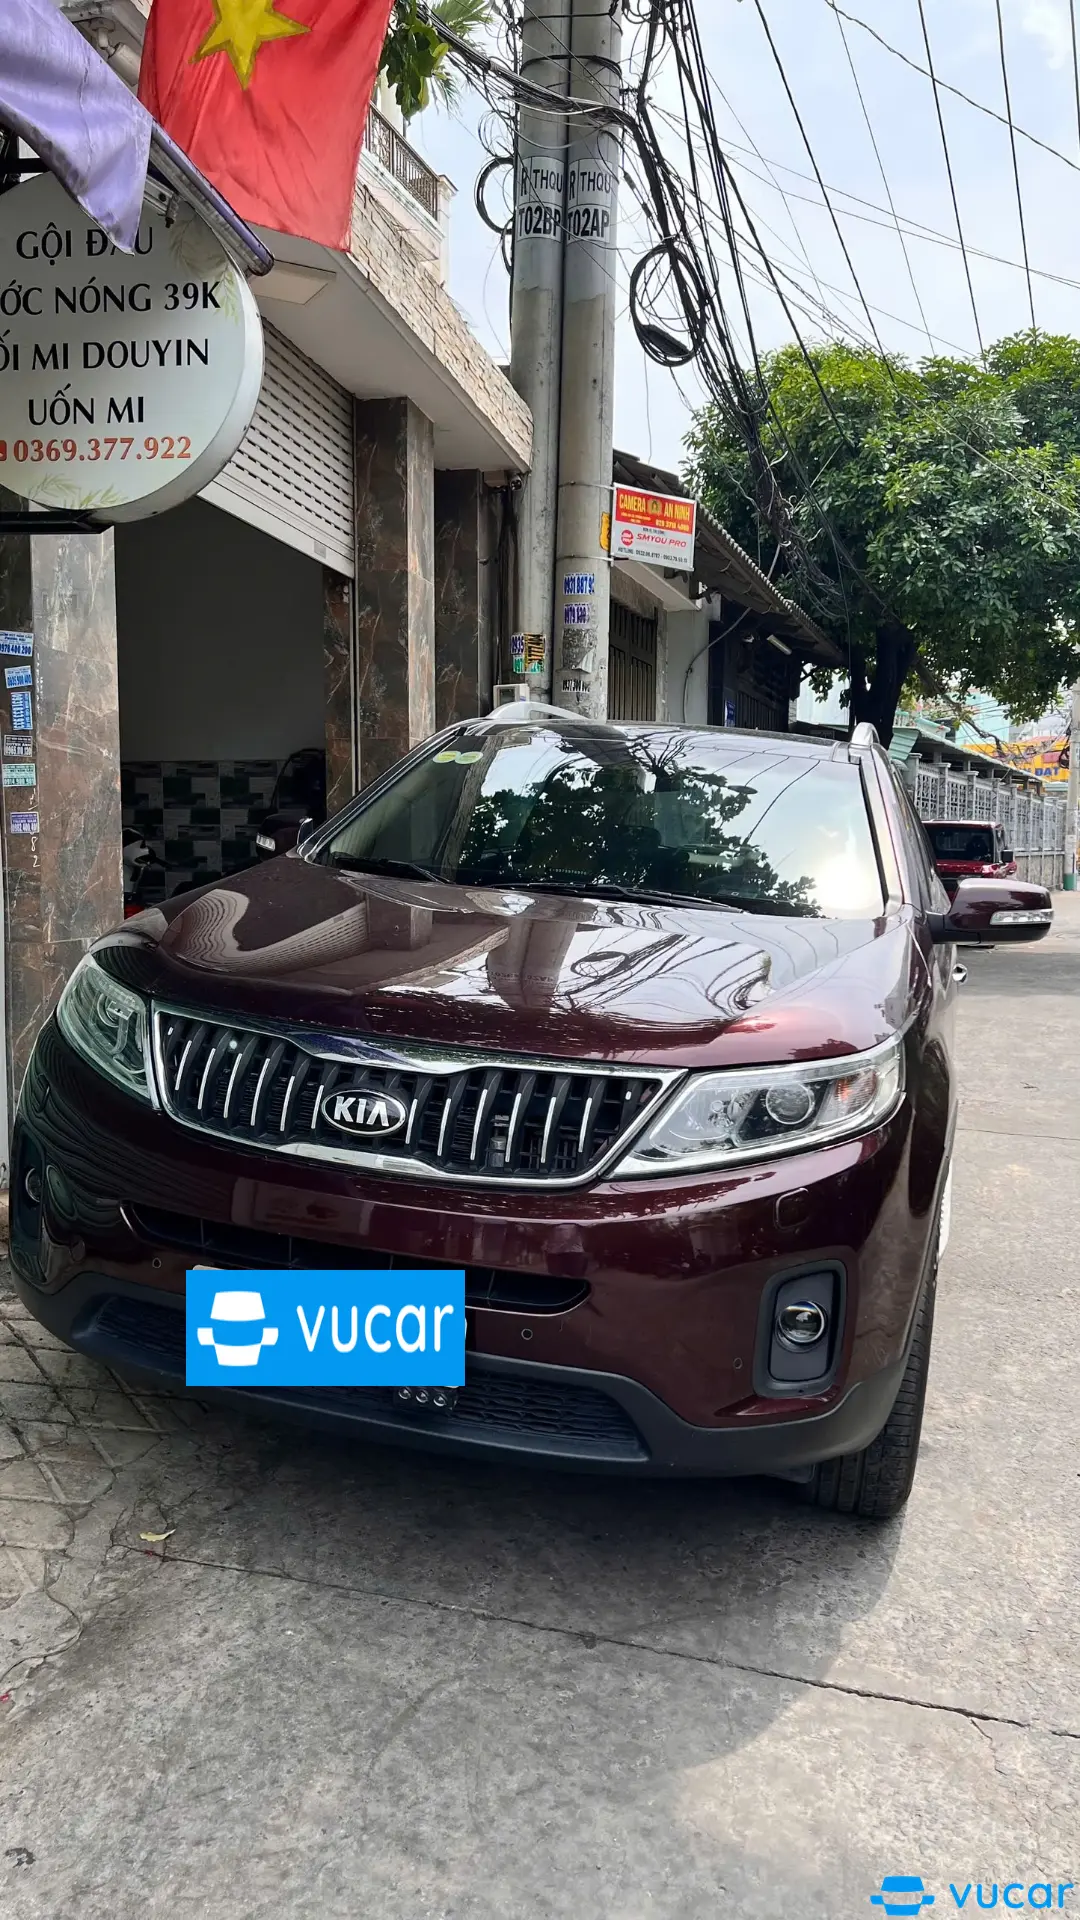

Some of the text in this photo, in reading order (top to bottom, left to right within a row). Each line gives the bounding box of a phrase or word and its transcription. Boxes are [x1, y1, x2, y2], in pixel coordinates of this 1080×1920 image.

[580, 171, 611, 194] THQU
[518, 205, 561, 237] T02BP
[567, 207, 610, 241] T02AP
[16, 222, 153, 266] GỘI ĐU
[54, 276, 151, 314] NÓNG
[163, 281, 221, 310] 39K
[31, 343, 69, 370] MI
[82, 338, 209, 369] DOUYIN
[28, 383, 145, 425] UỐN MI
[13, 436, 192, 462] 0369.377.922
[619, 494, 646, 513] CAMERA
[664, 503, 674, 518] AN
[675, 505, 690, 521] NINH
[636, 533, 667, 545] SMYOU
[668, 539, 687, 548] PRO
[333, 1095, 390, 1127] KIA
